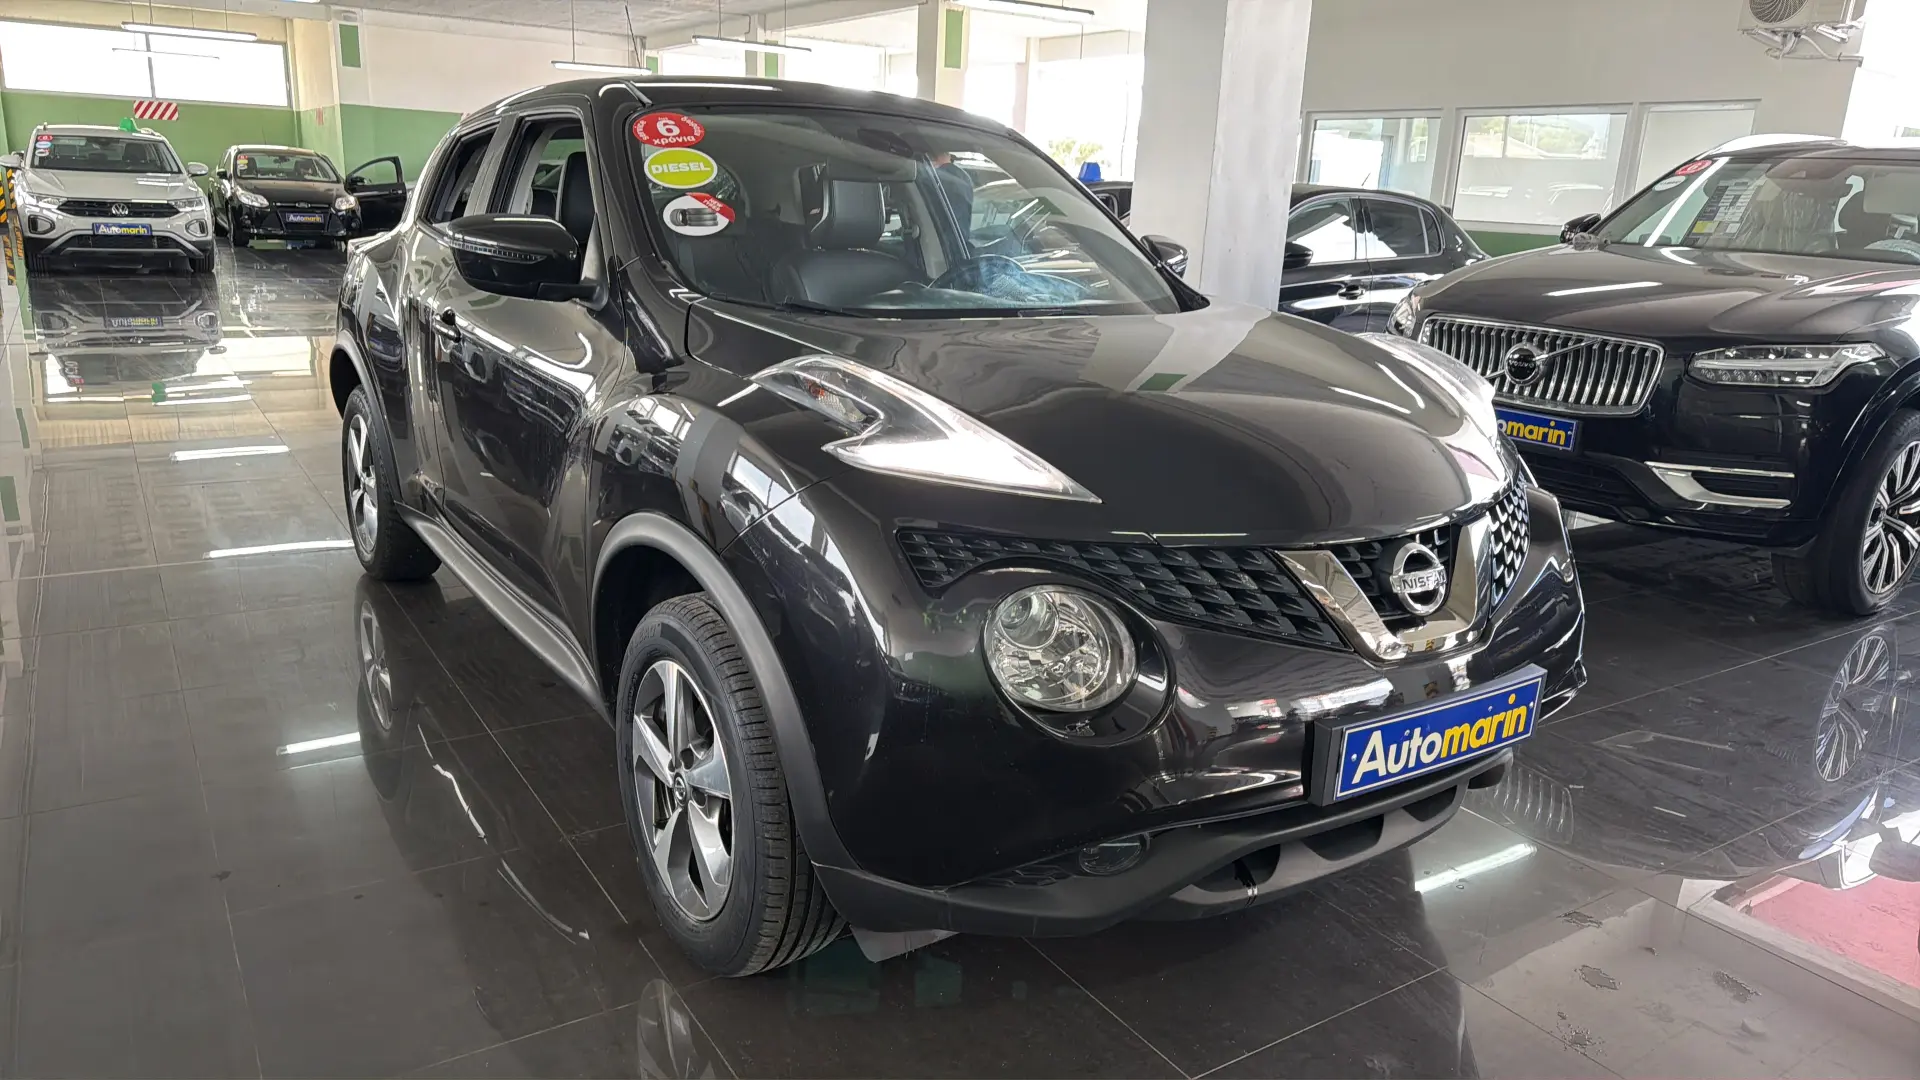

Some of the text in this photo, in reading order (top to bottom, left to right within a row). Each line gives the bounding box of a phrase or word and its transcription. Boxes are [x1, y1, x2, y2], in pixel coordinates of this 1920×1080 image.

[657, 120, 680, 136] 6
[653, 135, 696, 145] χρόνια
[651, 161, 710, 174] DIESEL
[99, 224, 147, 235] Automarin
[1497, 419, 1566, 445] omarin
[1352, 693, 1527, 784] Automarin
